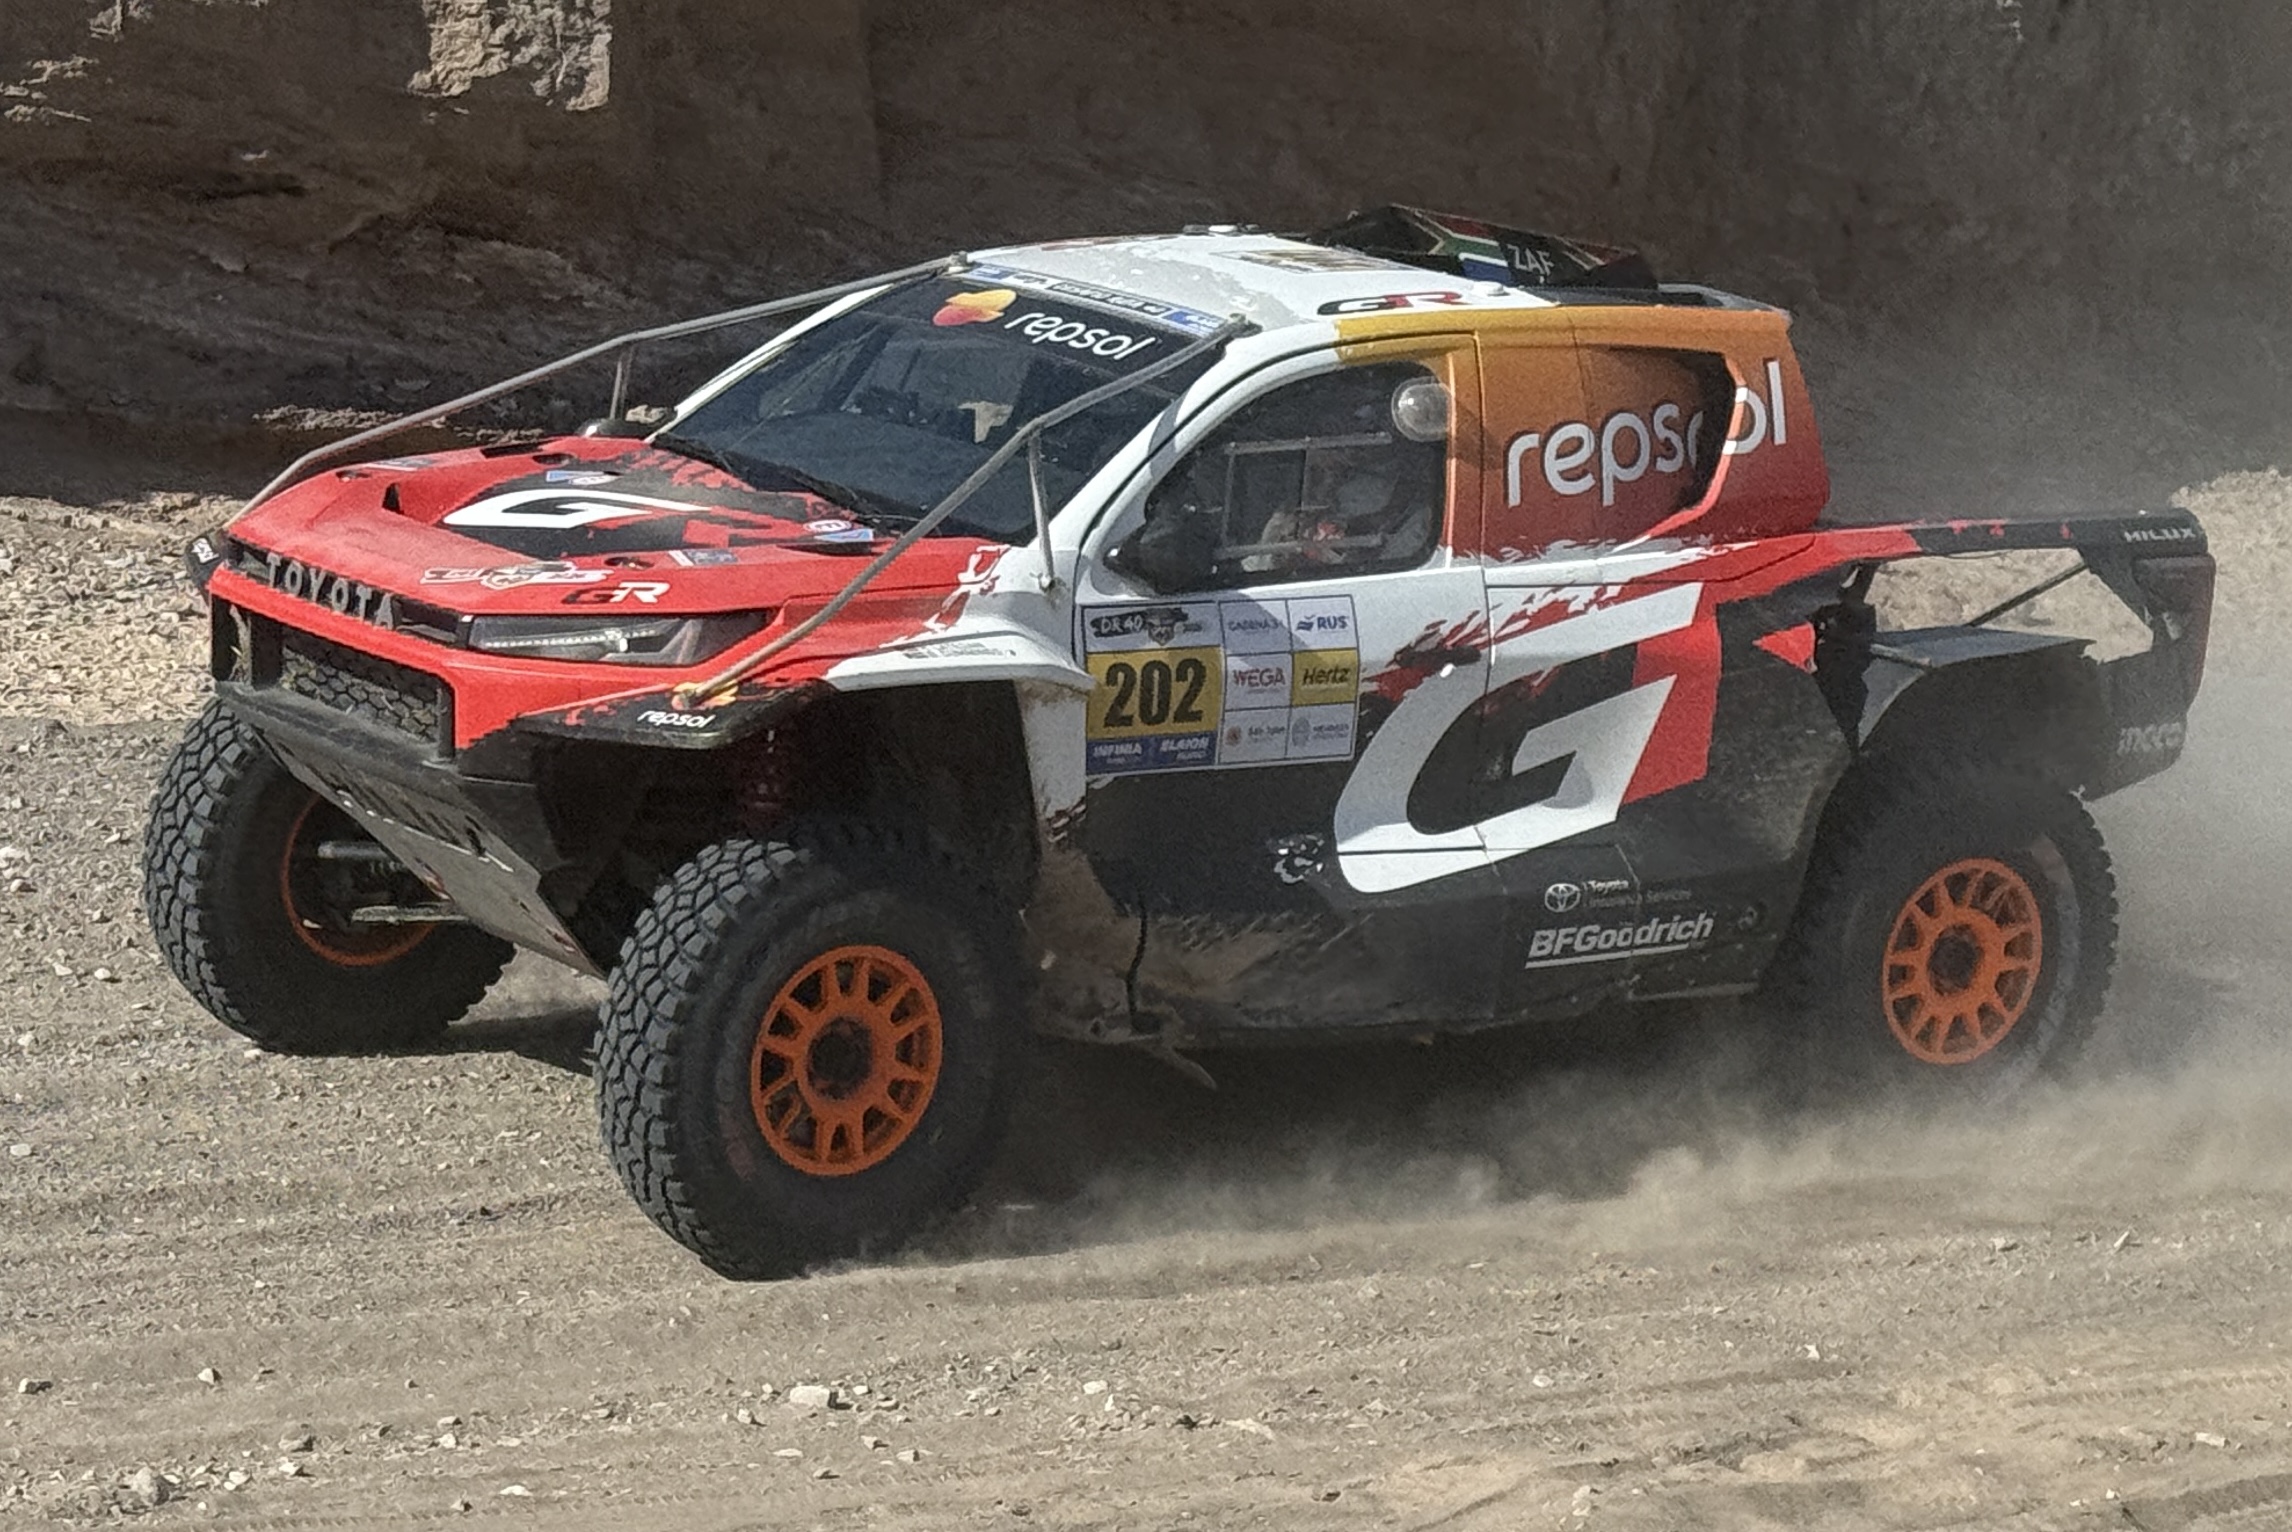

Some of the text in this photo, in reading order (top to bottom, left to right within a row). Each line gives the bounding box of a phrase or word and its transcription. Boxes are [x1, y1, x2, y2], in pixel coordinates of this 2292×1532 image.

[1507, 244, 1554, 276] ZAF
[1003, 311, 1157, 361] repsol
[1506, 358, 1787, 508] repsol
[265, 552, 394, 631] TOYOTA
[561, 581, 671, 605] GR
[1317, 615, 1349, 630] RUS
[1232, 667, 1287, 688] WEGA
[1302, 665, 1352, 686] Hertz
[1103, 658, 1207, 728] 202
[637, 709, 716, 728] repsol
[1528, 910, 1715, 958] BFGoodrich
